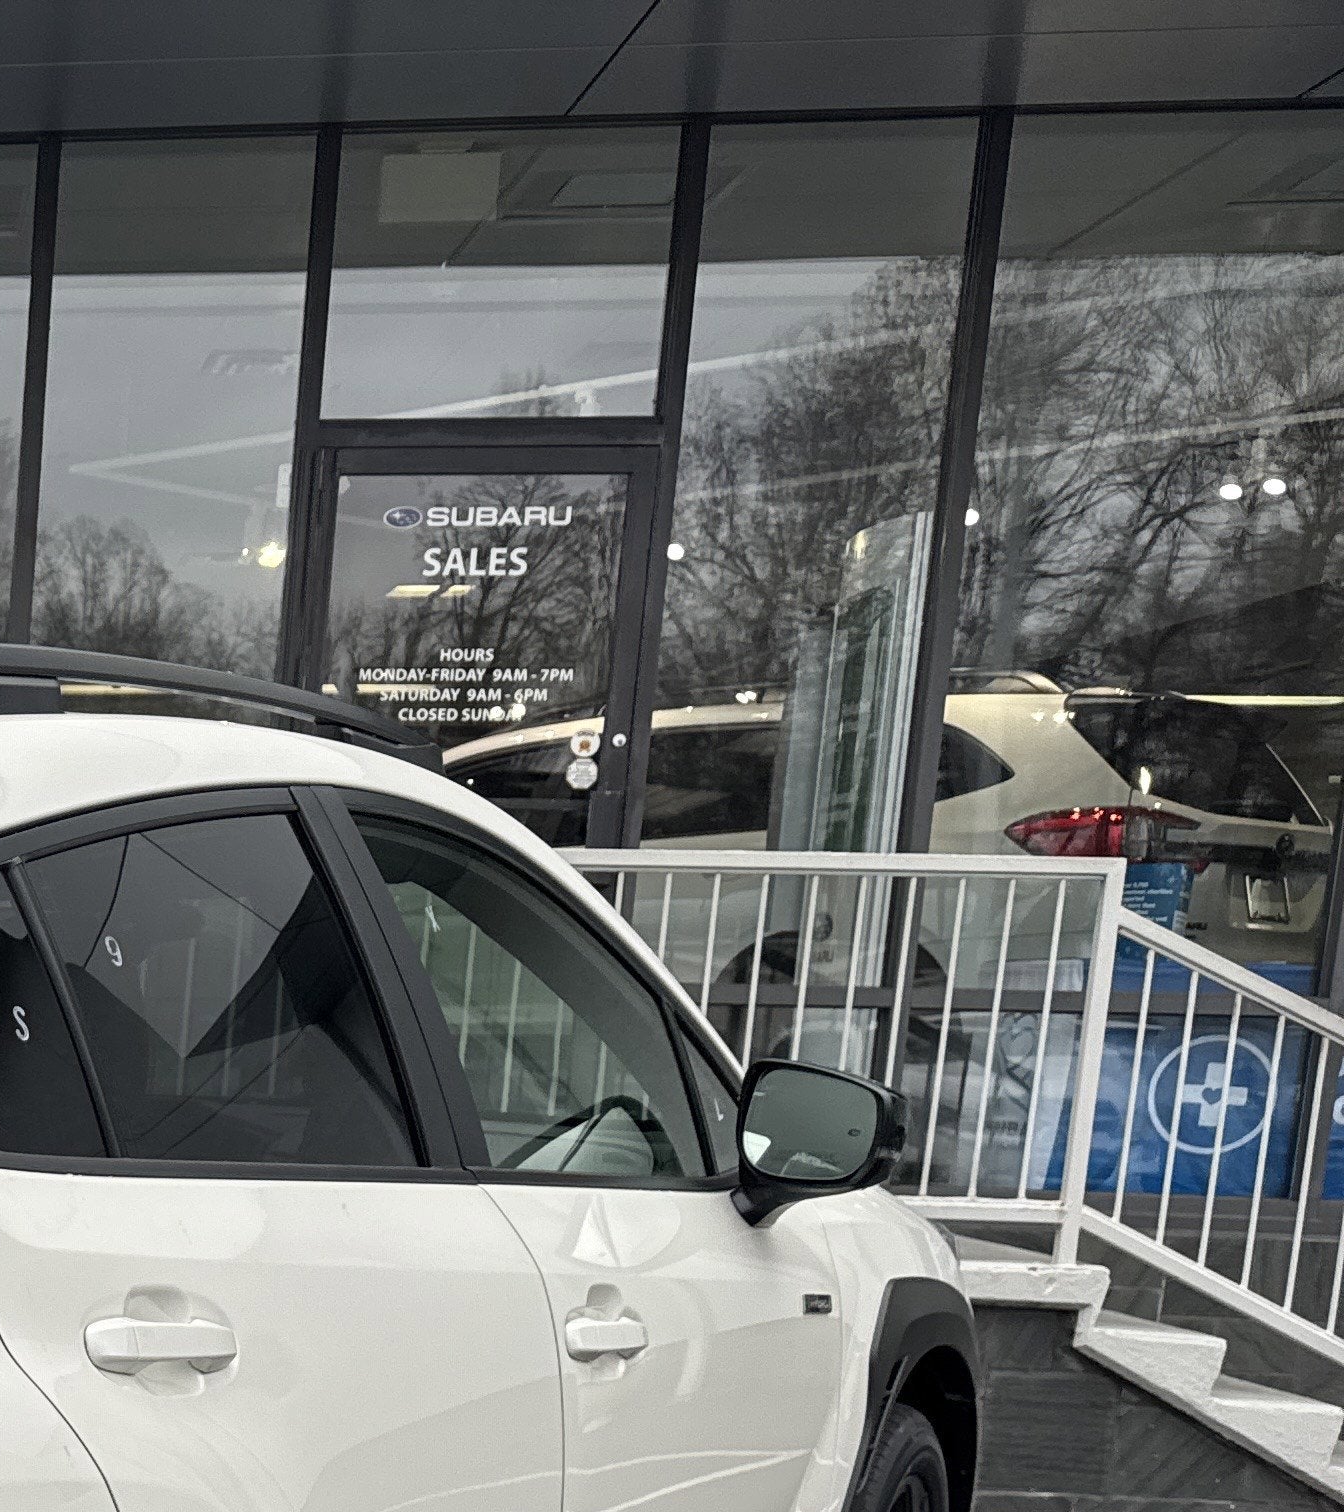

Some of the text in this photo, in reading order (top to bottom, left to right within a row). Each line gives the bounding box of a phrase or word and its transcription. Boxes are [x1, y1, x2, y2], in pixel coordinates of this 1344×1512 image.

[426, 505, 573, 527] SUBARU
[422, 546, 528, 577] SALES
[439, 648, 495, 662] HOURS
[358, 667, 486, 683] MONDAY-FRIDAY
[492, 667, 528, 683] 9AM
[540, 667, 574, 683] 7PM
[379, 687, 461, 702] SATURDAY
[466, 687, 502, 702] 9AM
[514, 687, 548, 702] 6PM
[397, 707, 459, 722] CLOSED
[104, 935, 124, 967] 9
[12, 1005, 30, 1042] S
